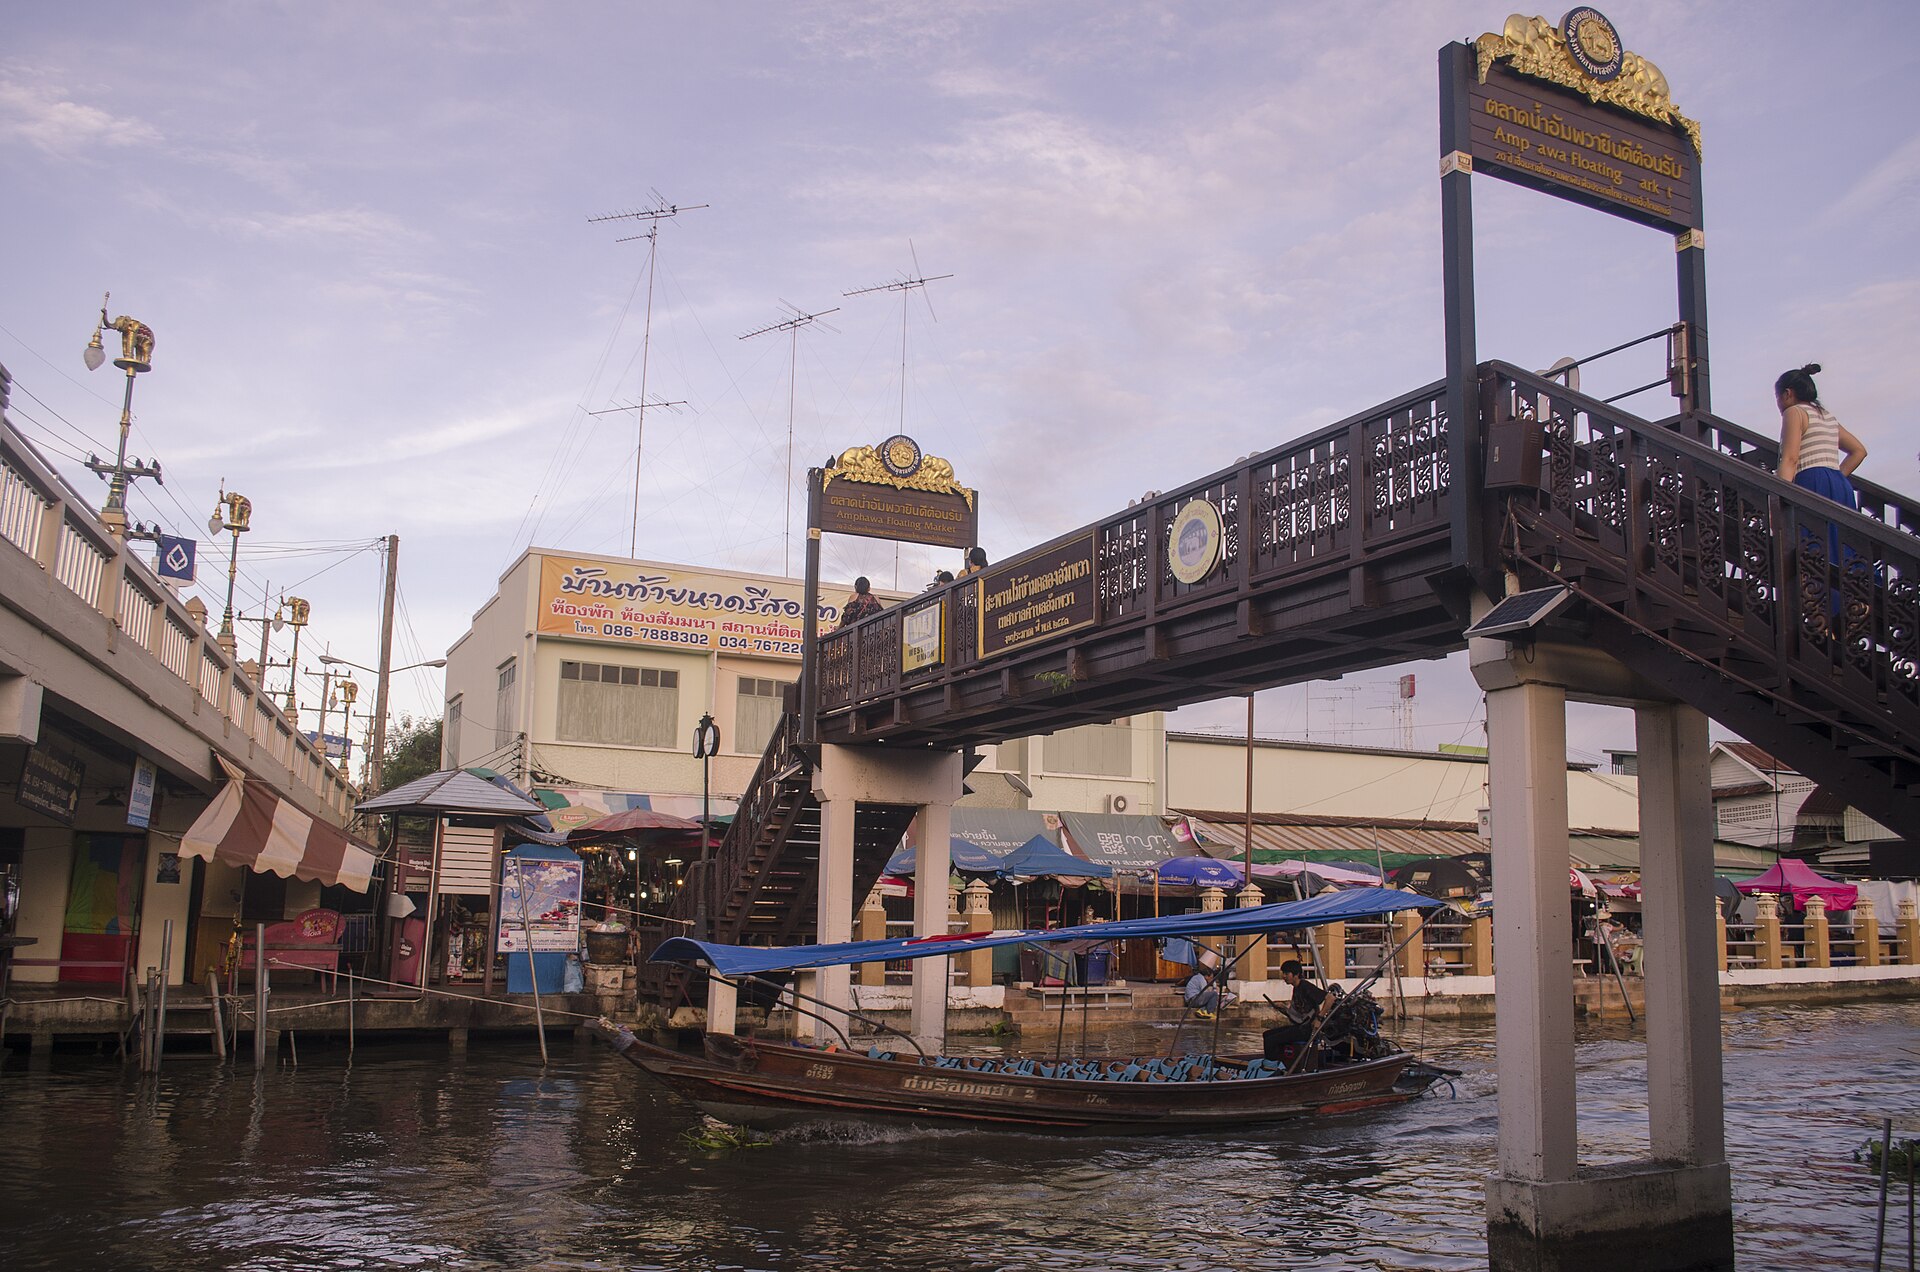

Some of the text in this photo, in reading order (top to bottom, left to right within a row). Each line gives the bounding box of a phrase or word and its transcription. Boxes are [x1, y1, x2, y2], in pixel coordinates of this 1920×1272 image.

[1485, 98, 1682, 179] ตลาดน้ำอัมพวายินดีต้อนรับ
[1571, 152, 1623, 184] Floating
[830, 494, 962, 522] ตลาดน้ำอัมพวายินดีต้อนรับ
[836, 510, 957, 533] Amphawa Floating Market
[562, 567, 838, 621] บ้านท้ายหาดรีสอท
[551, 599, 614, 620] ห้องพัก
[620, 607, 716, 631] ห้องสัมมนา
[998, 592, 1075, 629] เทศบาลตำบลอัมพวา
[575, 621, 804, 655] โทร. 086-7888302 034-76722
[962, 829, 998, 840] ง่ายขึ้น
[1024, 1088, 1035, 1099] 2
